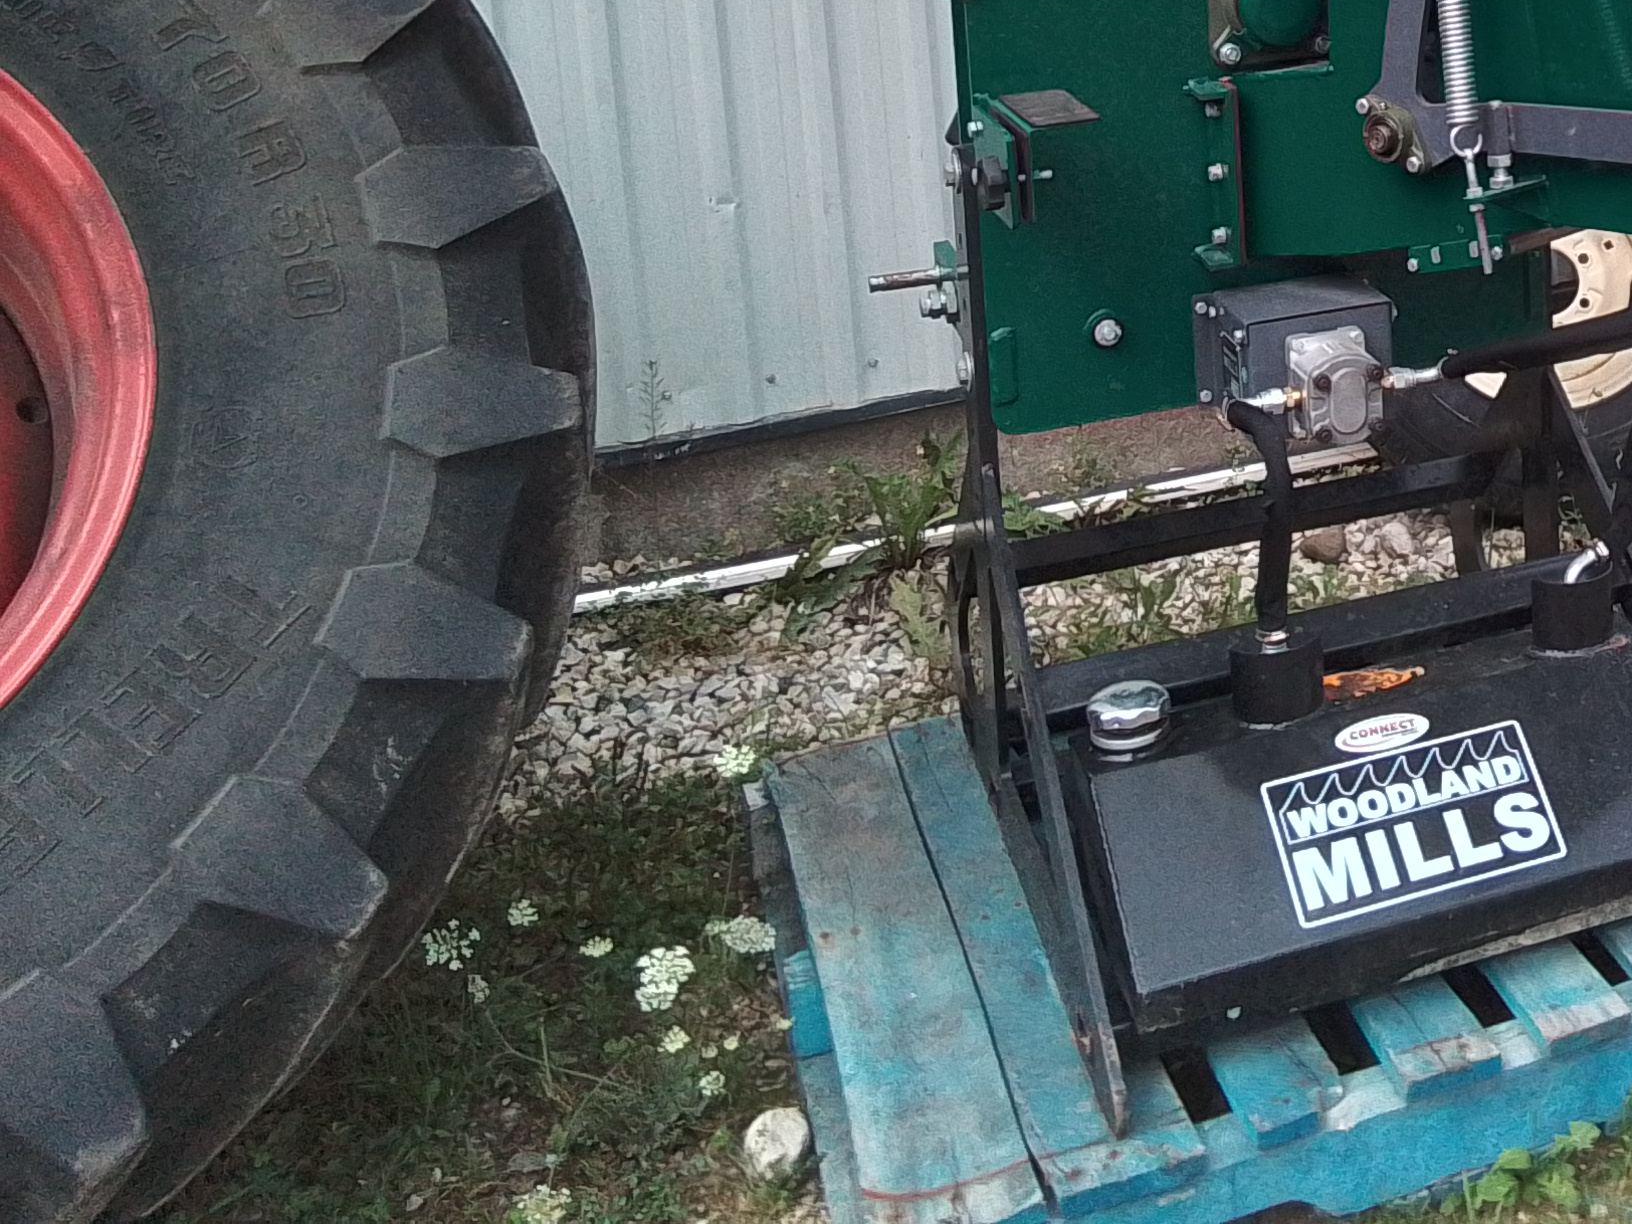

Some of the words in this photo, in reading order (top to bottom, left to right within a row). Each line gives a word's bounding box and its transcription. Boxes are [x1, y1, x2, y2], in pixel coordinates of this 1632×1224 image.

[1349, 718, 1415, 740] CONNECT
[1287, 754, 1522, 838] WOODLAND
[1291, 791, 1551, 912] MILLS
